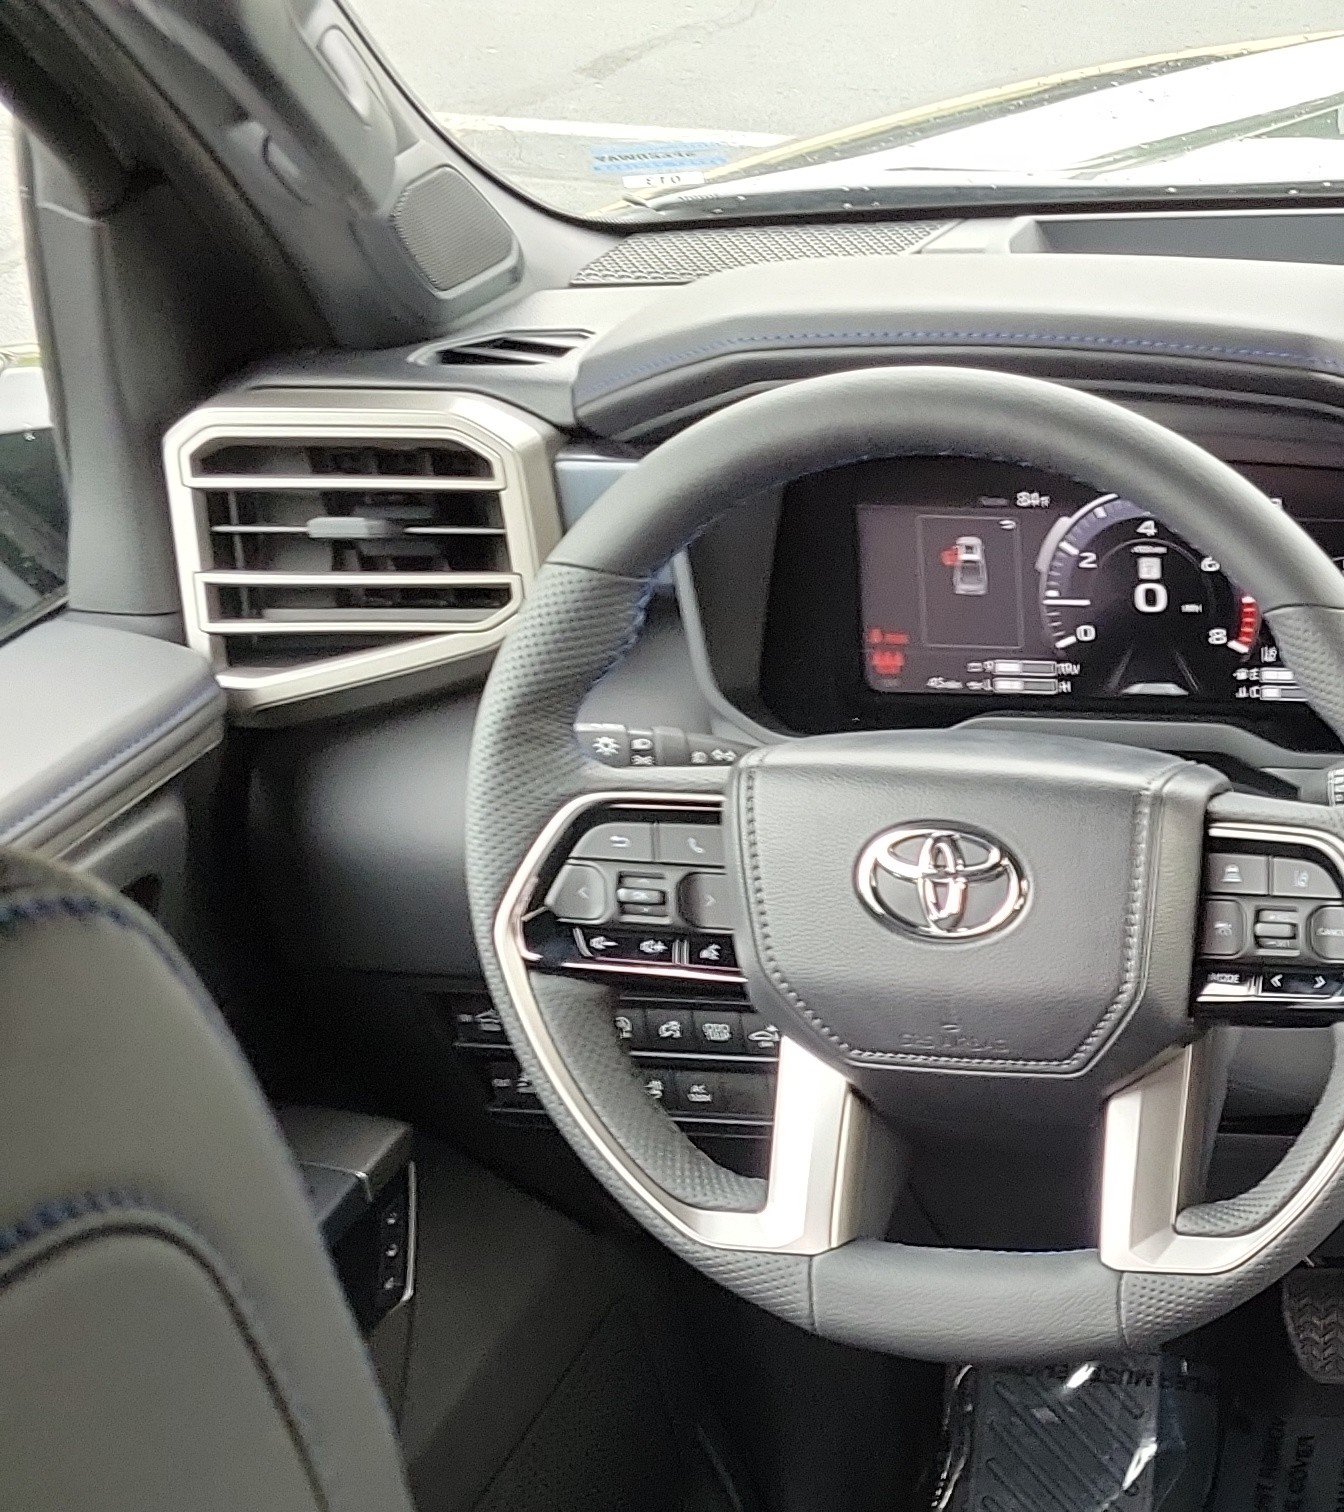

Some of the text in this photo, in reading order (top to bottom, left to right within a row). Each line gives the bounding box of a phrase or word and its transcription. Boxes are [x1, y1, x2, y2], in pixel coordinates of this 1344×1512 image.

[1135, 519, 1158, 538] 4
[1078, 551, 1098, 569] 2
[1200, 555, 1221, 573] 6
[1133, 582, 1168, 614] 0
[1075, 624, 1096, 642] 0
[1207, 627, 1228, 645] 8
[1207, 972, 1241, 984] MODE
